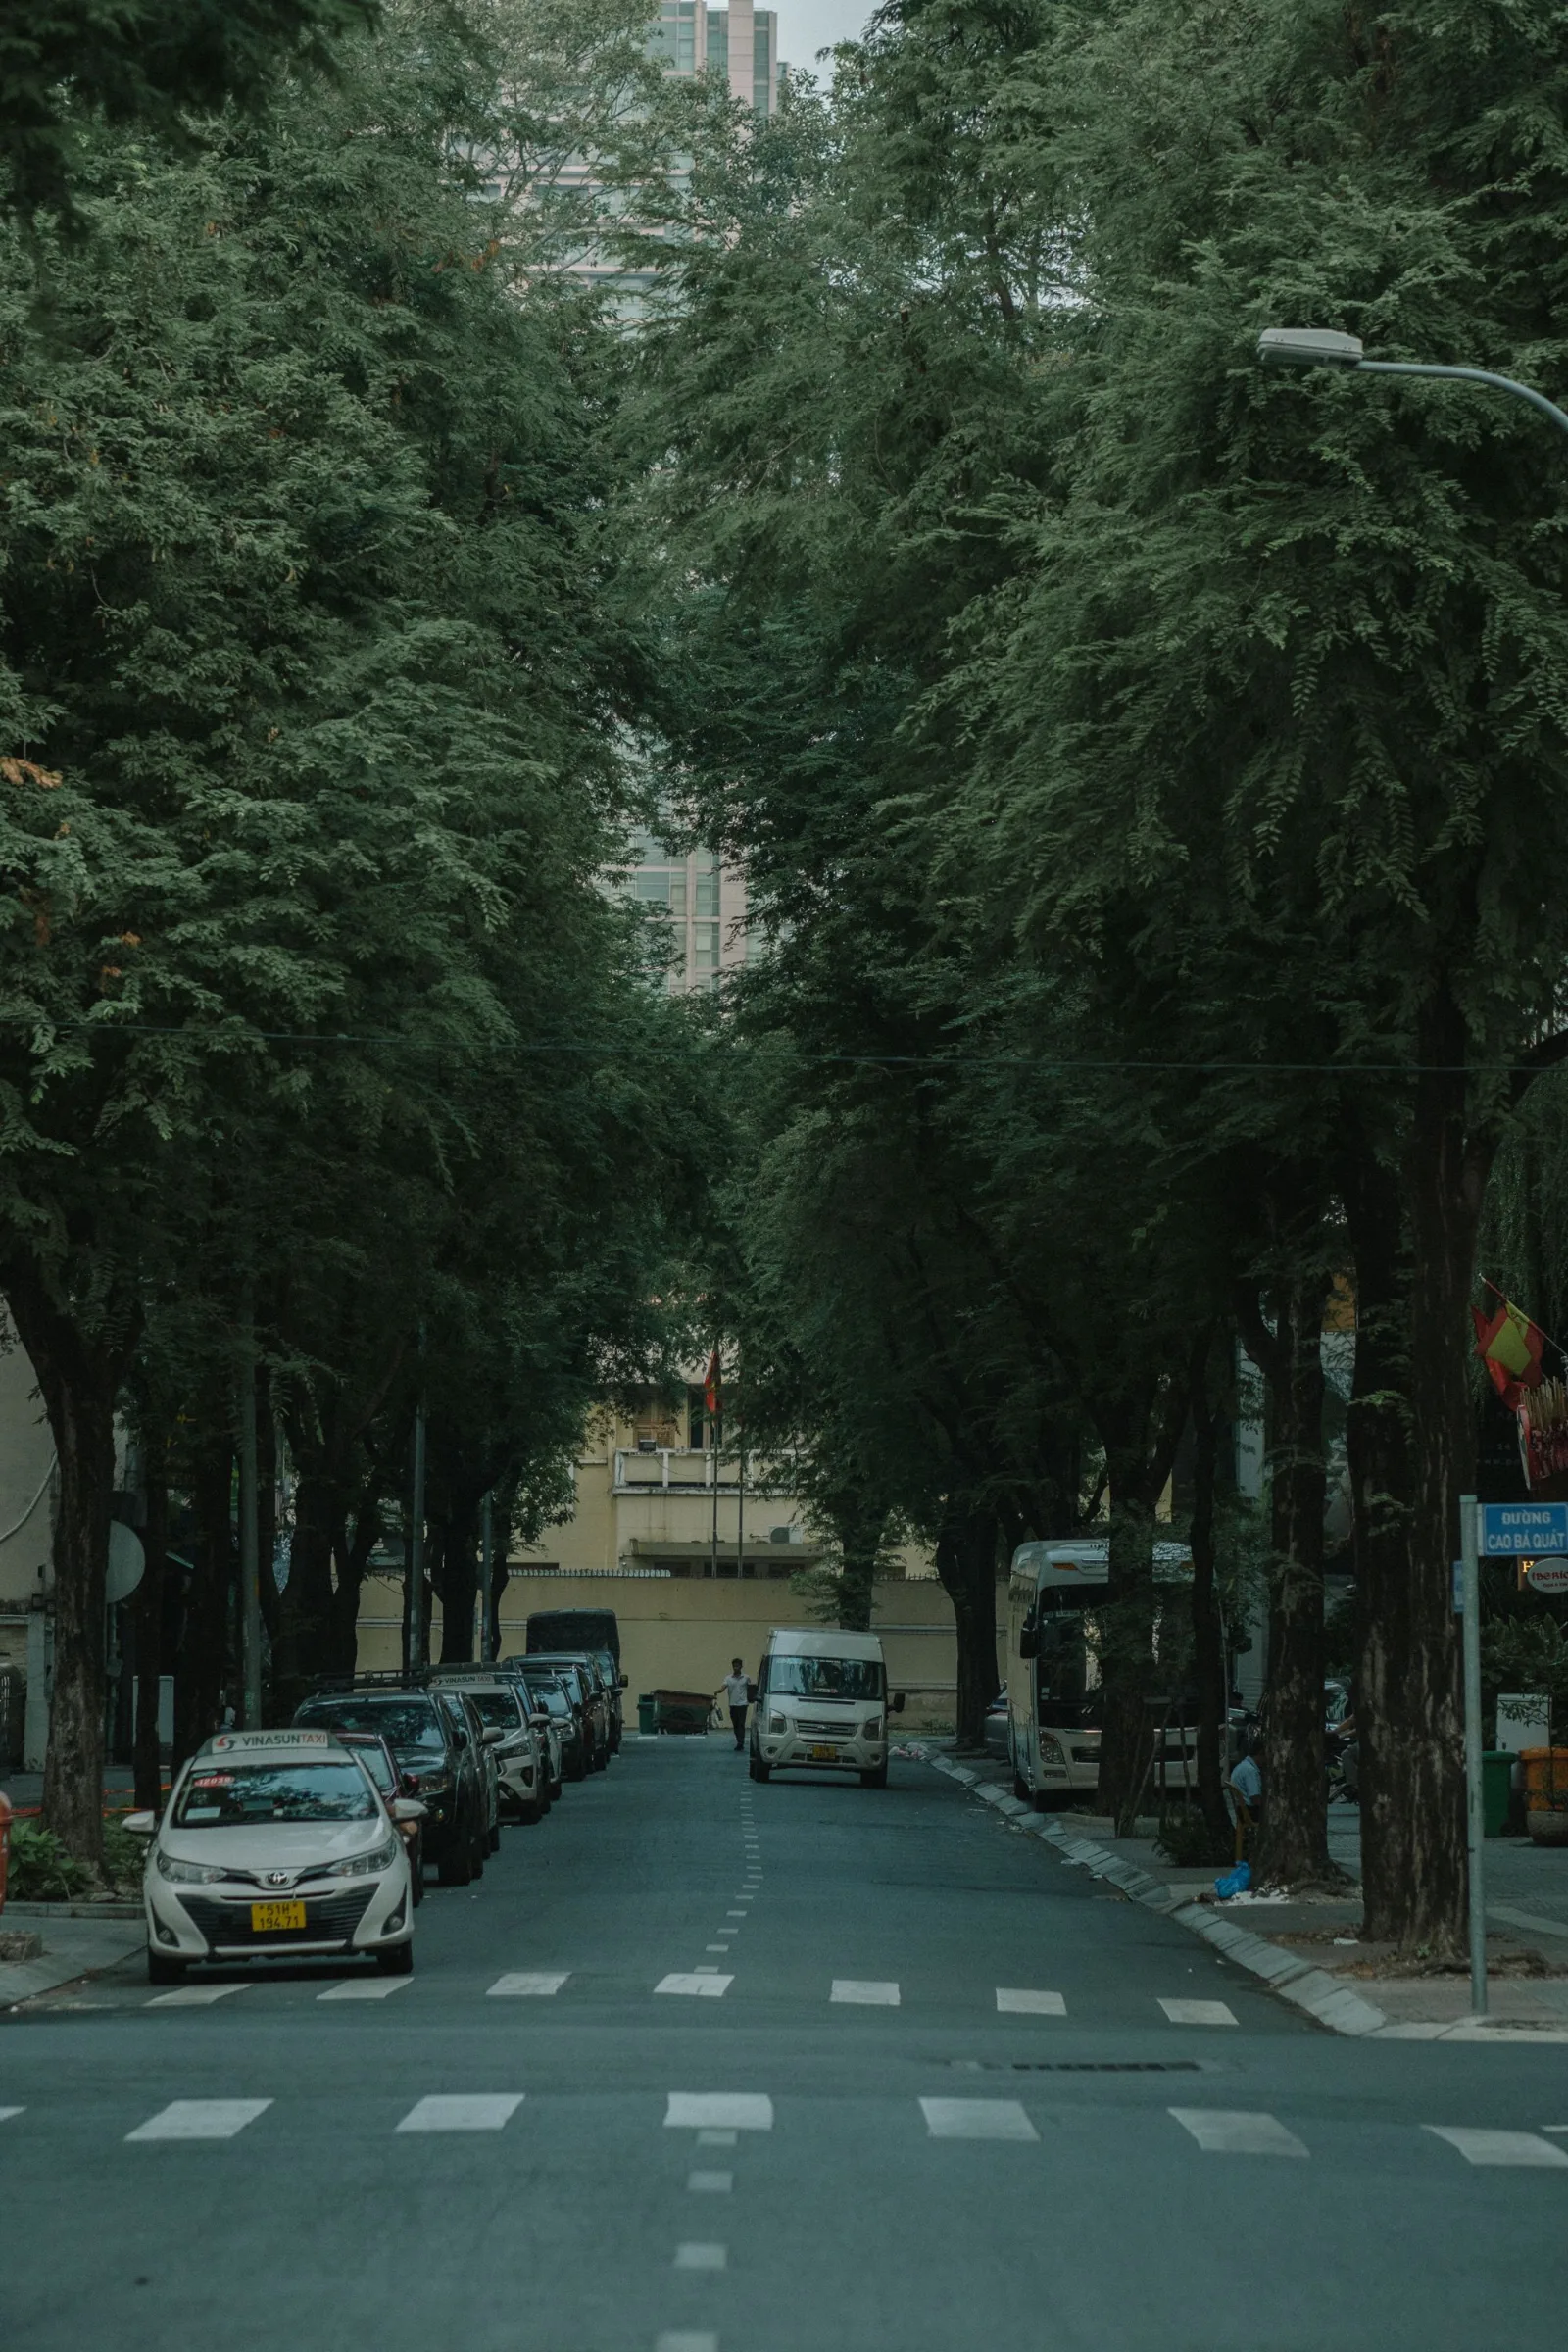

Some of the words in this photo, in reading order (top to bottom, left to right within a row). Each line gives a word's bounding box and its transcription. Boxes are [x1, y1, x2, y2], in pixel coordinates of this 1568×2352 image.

[1488, 1532, 1511, 1549] CAO
[1513, 1529, 1531, 1548] BÁ
[1533, 1528, 1565, 1548] QUÁT
[444, 1675, 476, 1684] VINASUN
[266, 1903, 290, 1916] 51H
[260, 1916, 299, 1928] 194.71
